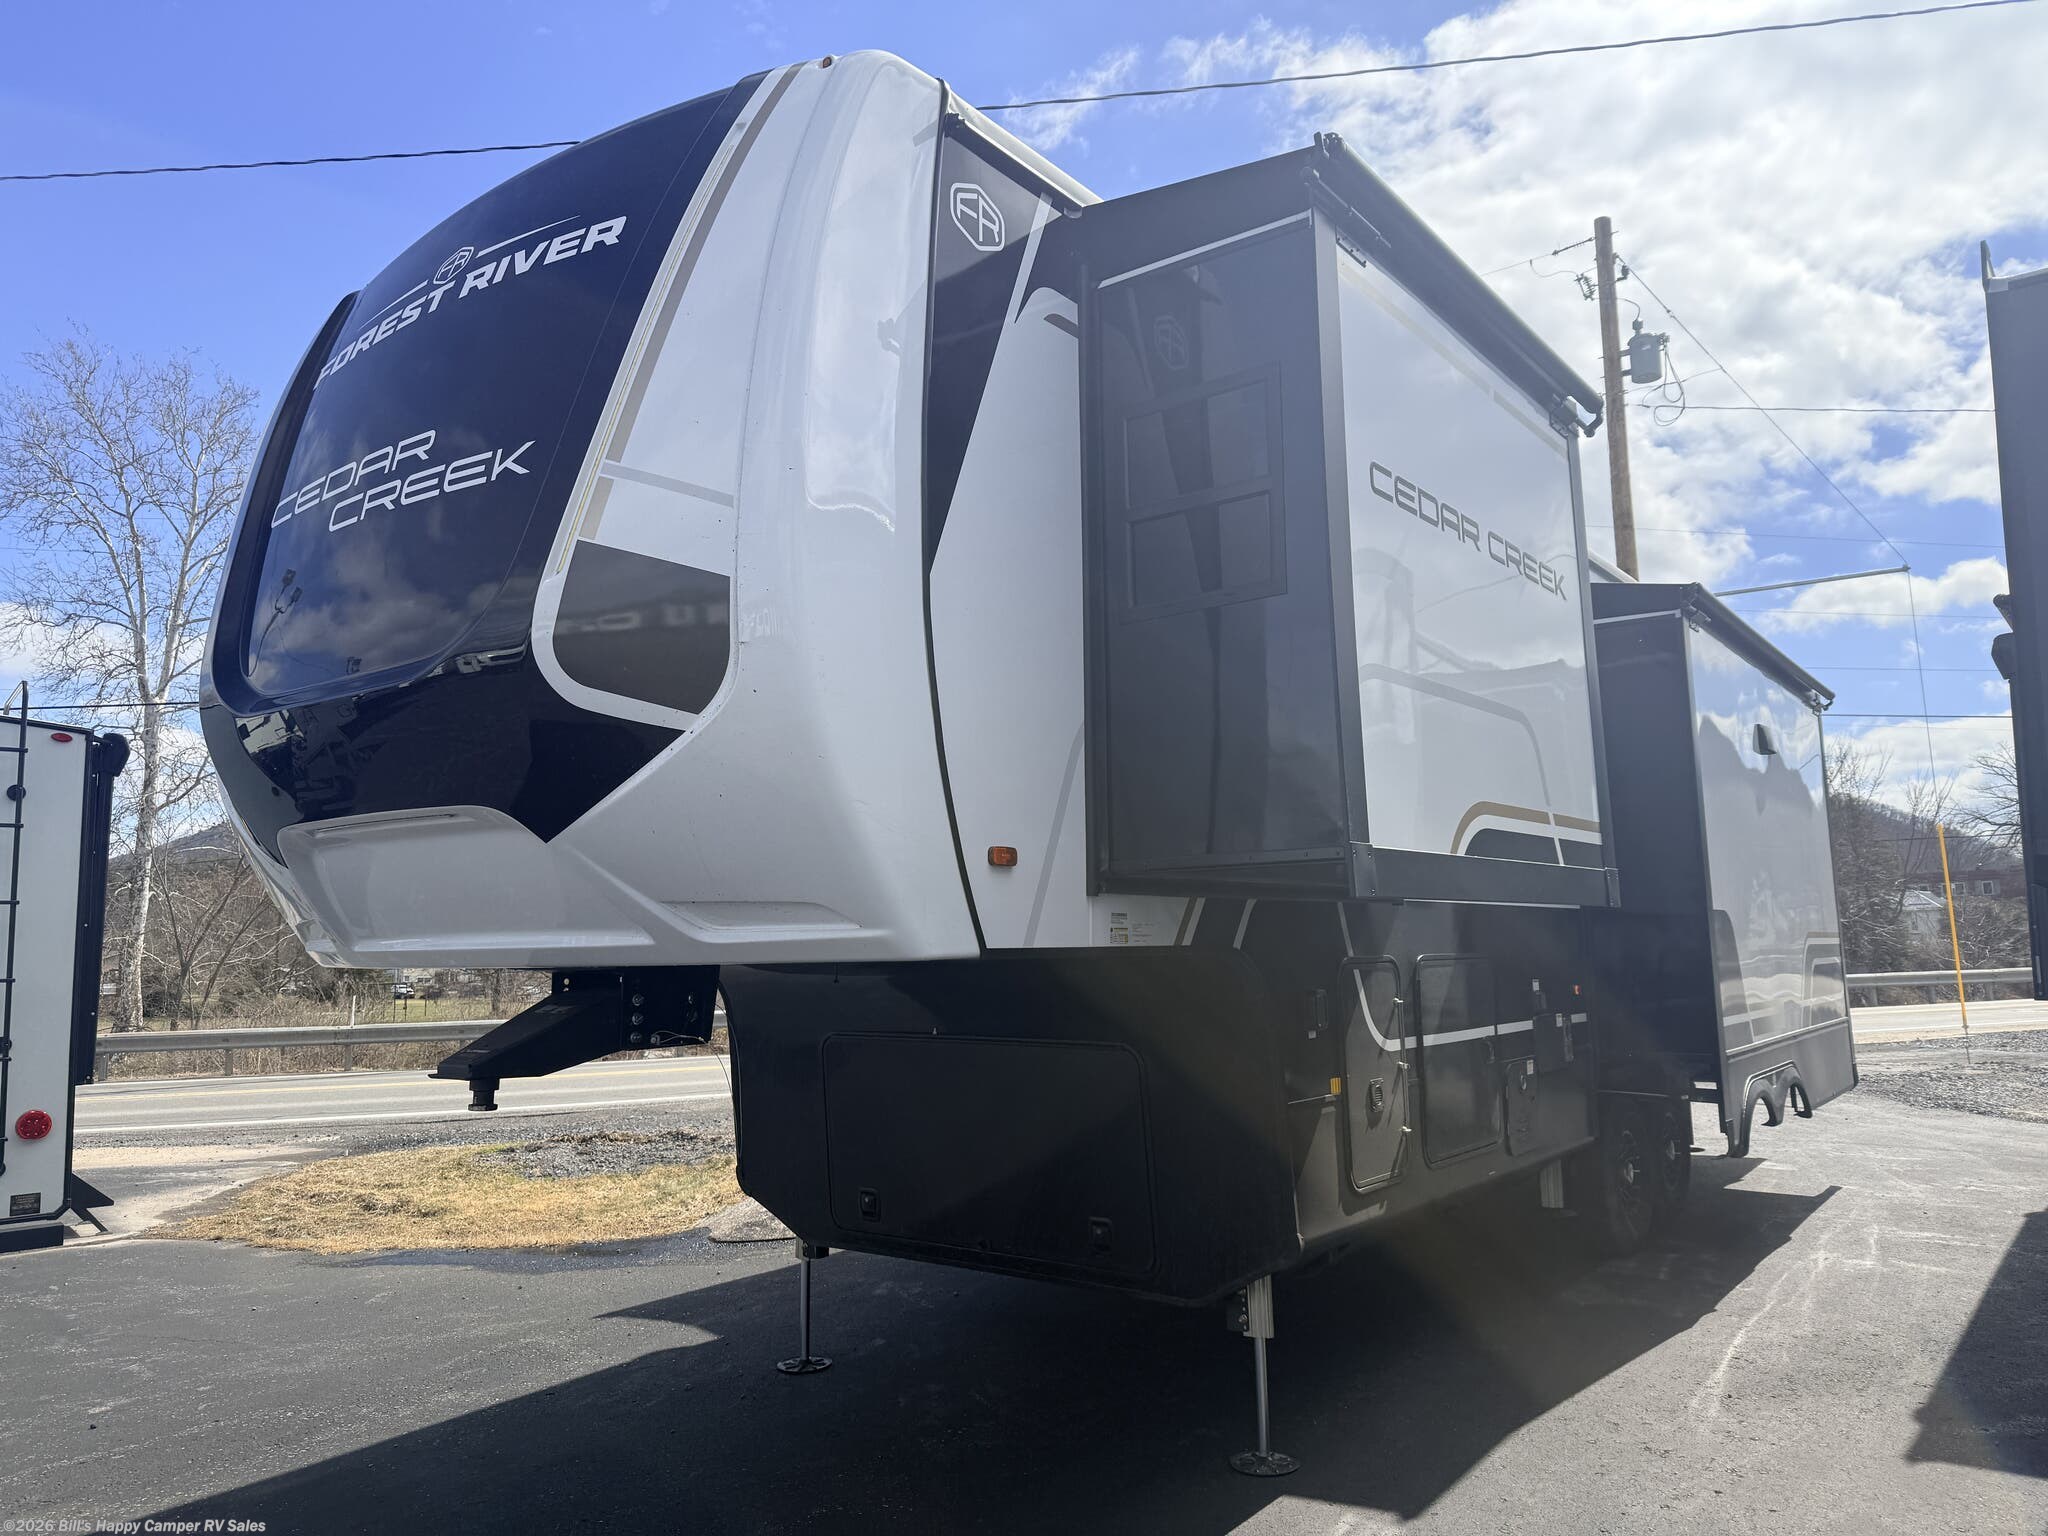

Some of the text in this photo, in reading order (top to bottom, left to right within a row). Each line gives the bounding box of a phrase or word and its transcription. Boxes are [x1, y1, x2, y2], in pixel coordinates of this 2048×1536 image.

[313, 216, 627, 391] FOREST RIVER
[271, 430, 436, 529] CEDAR
[329, 440, 536, 532] CREEK
[1369, 461, 1567, 601] CEDAR CREEK
